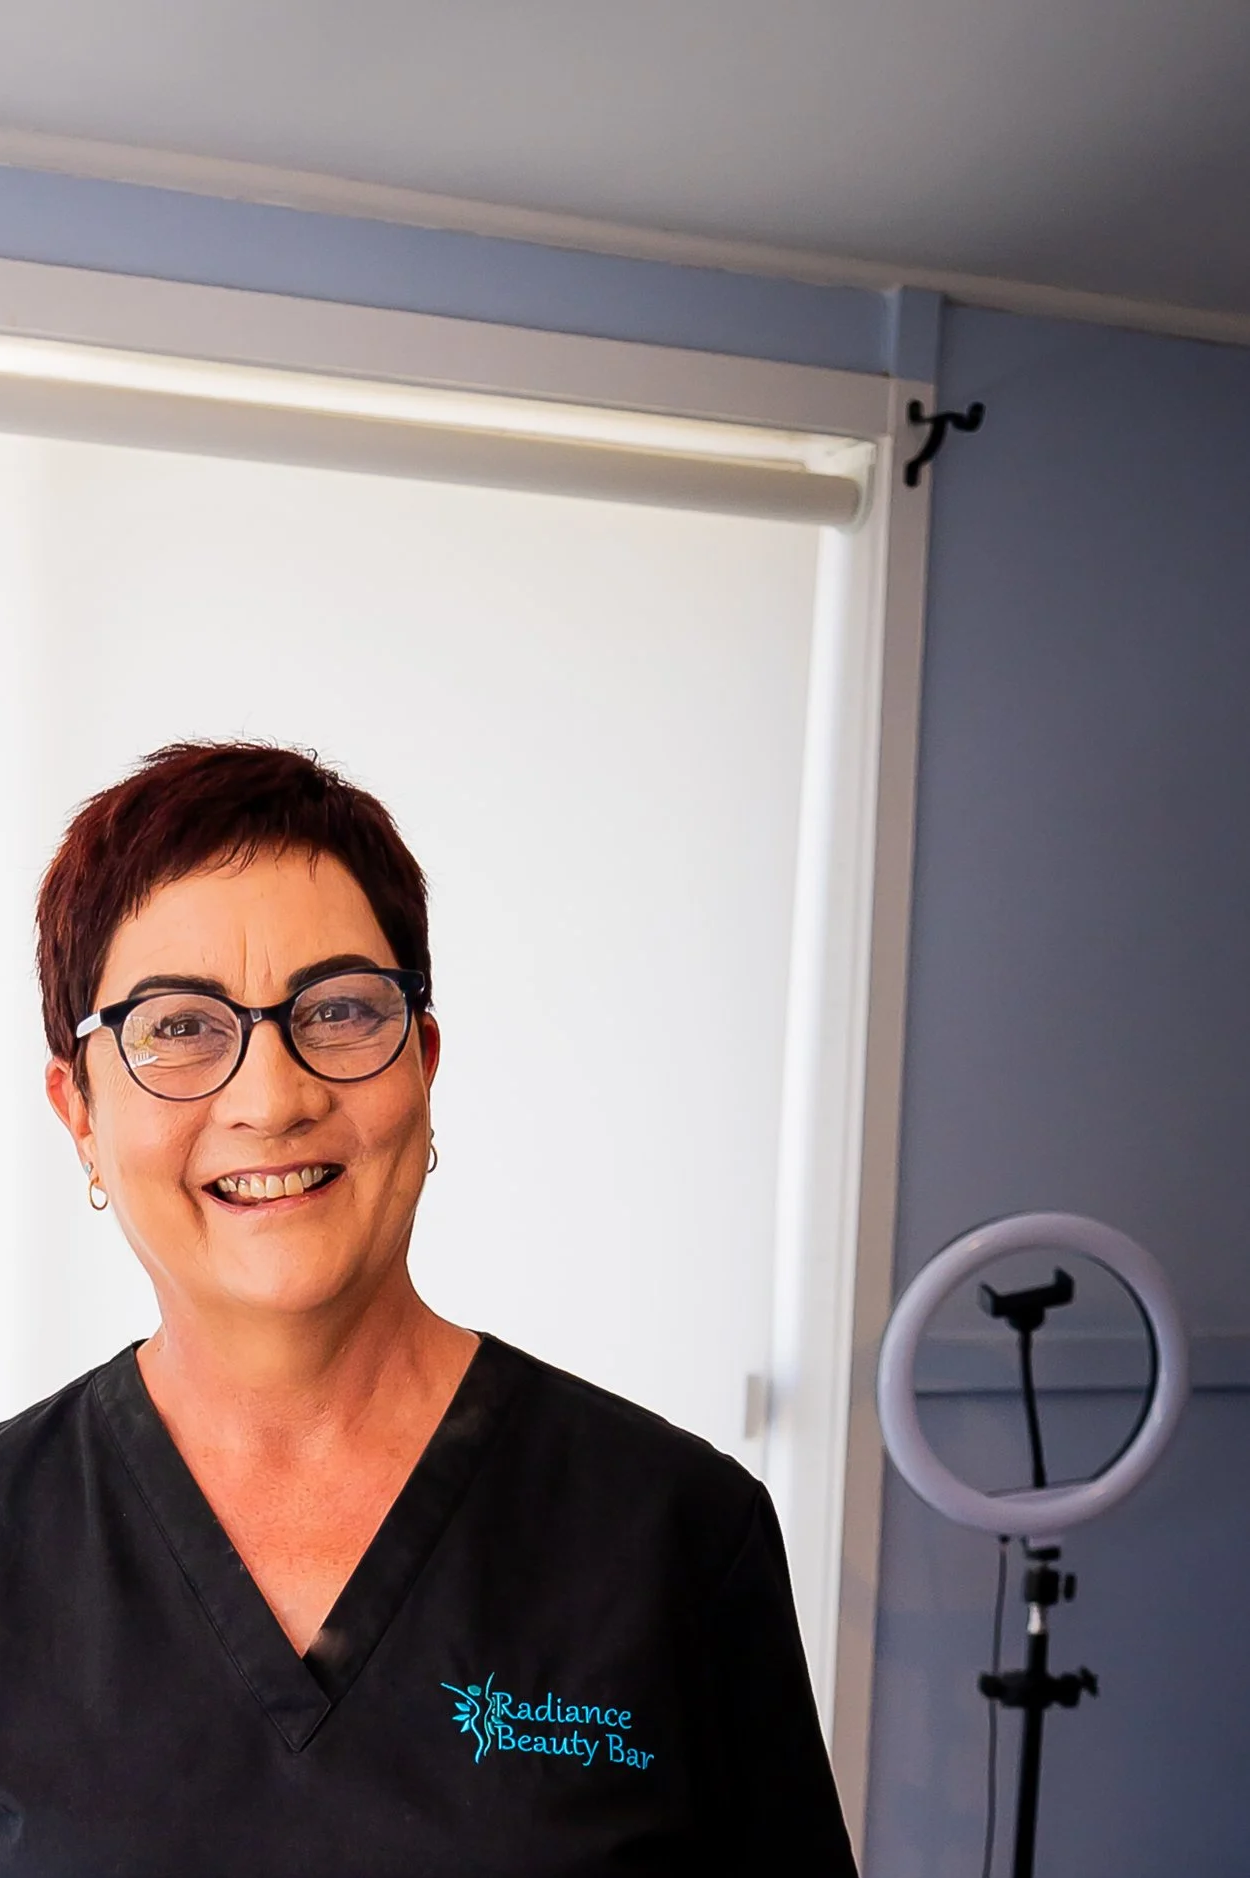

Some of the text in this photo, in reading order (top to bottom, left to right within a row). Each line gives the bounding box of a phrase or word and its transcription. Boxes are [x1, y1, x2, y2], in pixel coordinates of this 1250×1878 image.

[492, 1691, 632, 1730] Radiance
[493, 1723, 655, 1770] Beauty Bar
